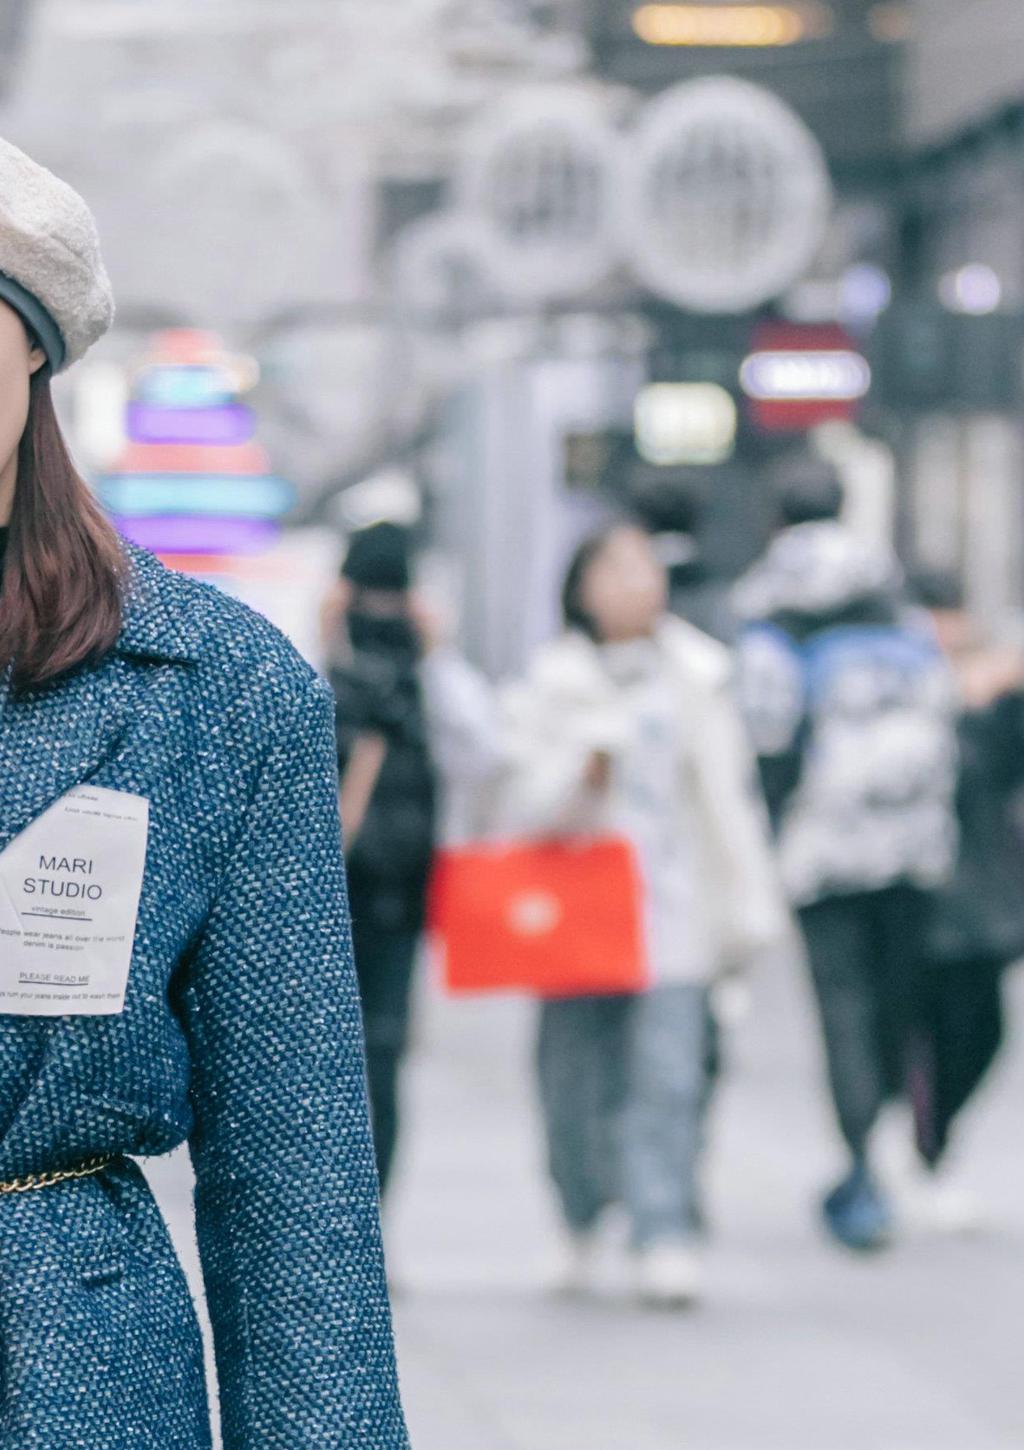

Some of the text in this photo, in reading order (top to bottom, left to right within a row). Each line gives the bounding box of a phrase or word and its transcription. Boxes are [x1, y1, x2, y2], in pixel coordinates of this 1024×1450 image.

[39, 854, 93, 874] MARI
[23, 877, 102, 900] STUDIO
[60, 908, 85, 916] edition
[19, 972, 90, 983] PLEASE READ ME
